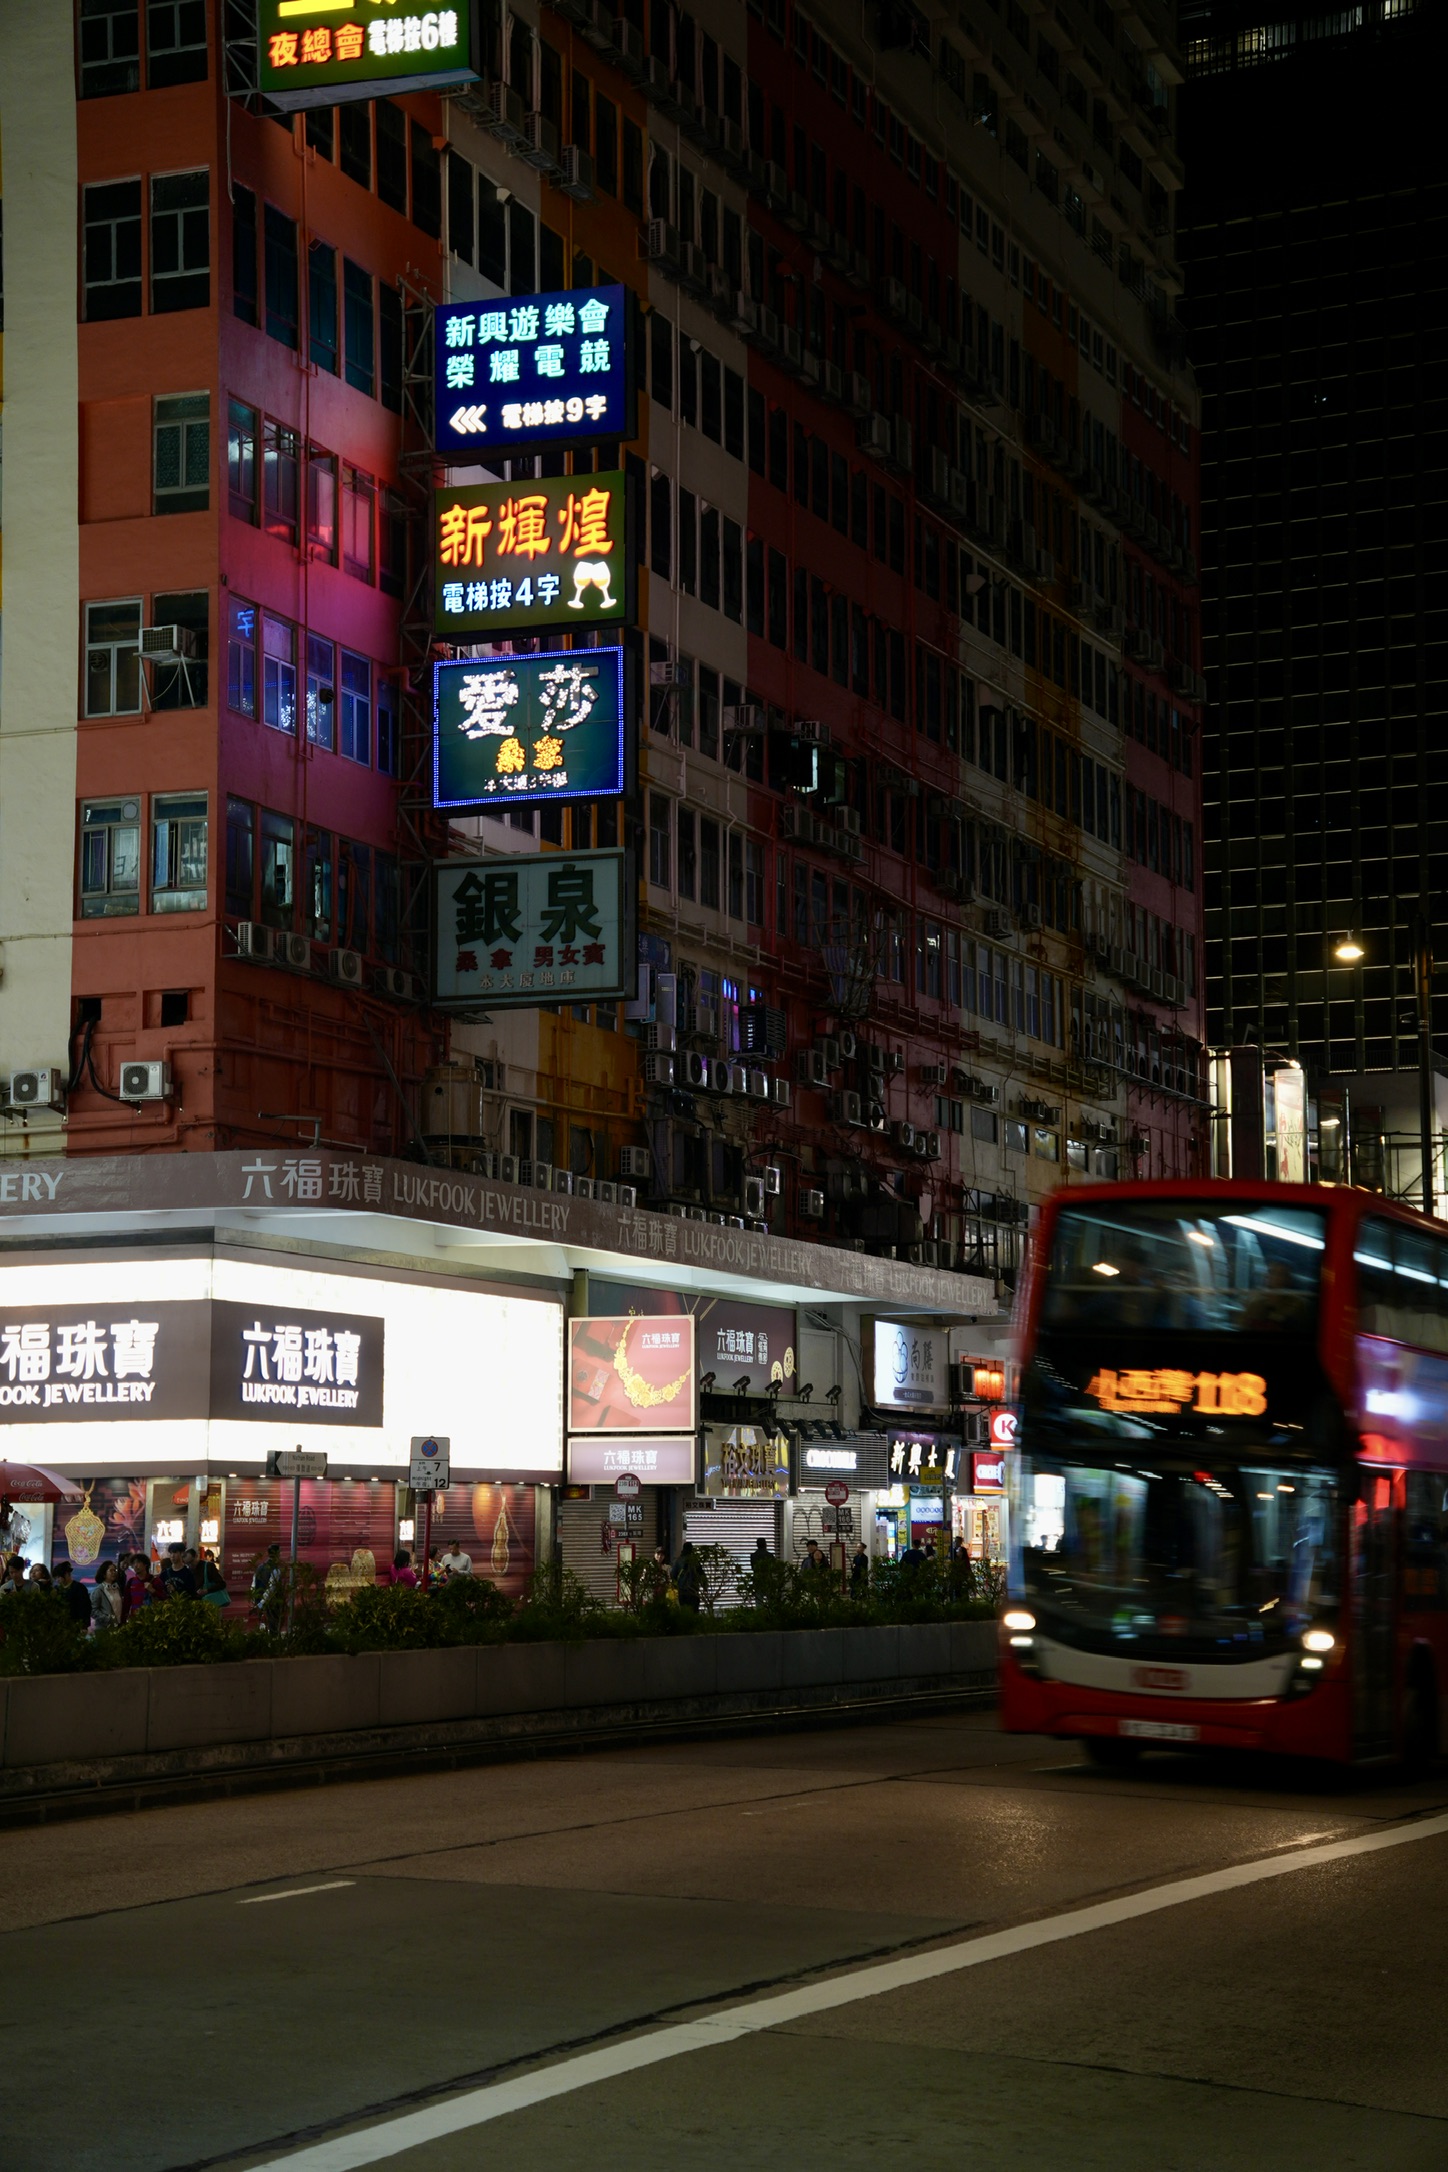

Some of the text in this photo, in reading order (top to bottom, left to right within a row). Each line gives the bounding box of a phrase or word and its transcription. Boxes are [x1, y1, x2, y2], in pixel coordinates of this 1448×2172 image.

[268, 21, 365, 68] 夜總會
[445, 298, 609, 348] 新興遊樂會
[446, 338, 611, 389] 榮耀電競
[502, 394, 607, 429] 電梯按9字
[440, 487, 614, 568] 新輝煌
[442, 573, 560, 613] 電梯按4字
[458, 662, 599, 740] 愛莎
[452, 863, 603, 947] 銀泉
[456, 942, 606, 972] 桑拿 男女賓
[480, 970, 576, 989] 本大廈地庫
[0, 1172, 64, 1201] ERY
[241, 1158, 570, 1232] 六福珠寶 LUKFOOK JEWELLERY
[617, 1213, 812, 1275] 六福珠寶 LUKFOOK JEWELLERY
[889, 1270, 935, 1297] LUKFOOK
[936, 1278, 988, 1308] JEWELLERY
[0, 1319, 159, 1382] 福珠寶
[243, 1321, 361, 1386] 六福珠寶
[641, 1332, 680, 1345] 六福珠寶
[717, 1328, 754, 1355] 六福珠寶
[42, 1382, 156, 1408] JEWELLERY
[242, 1382, 359, 1408] LUKFOOK JEWELLERY
[1193, 1371, 1267, 1416] 118
[1001, 1419, 1015, 1434] K
[434, 1462, 441, 1472] 7
[603, 1450, 658, 1465] 六福珠寶
[434, 1478, 446, 1488] 12
[233, 1500, 269, 1517] 六福珠寶
[627, 1505, 642, 1513] MK
[627, 1513, 643, 1521] 165
